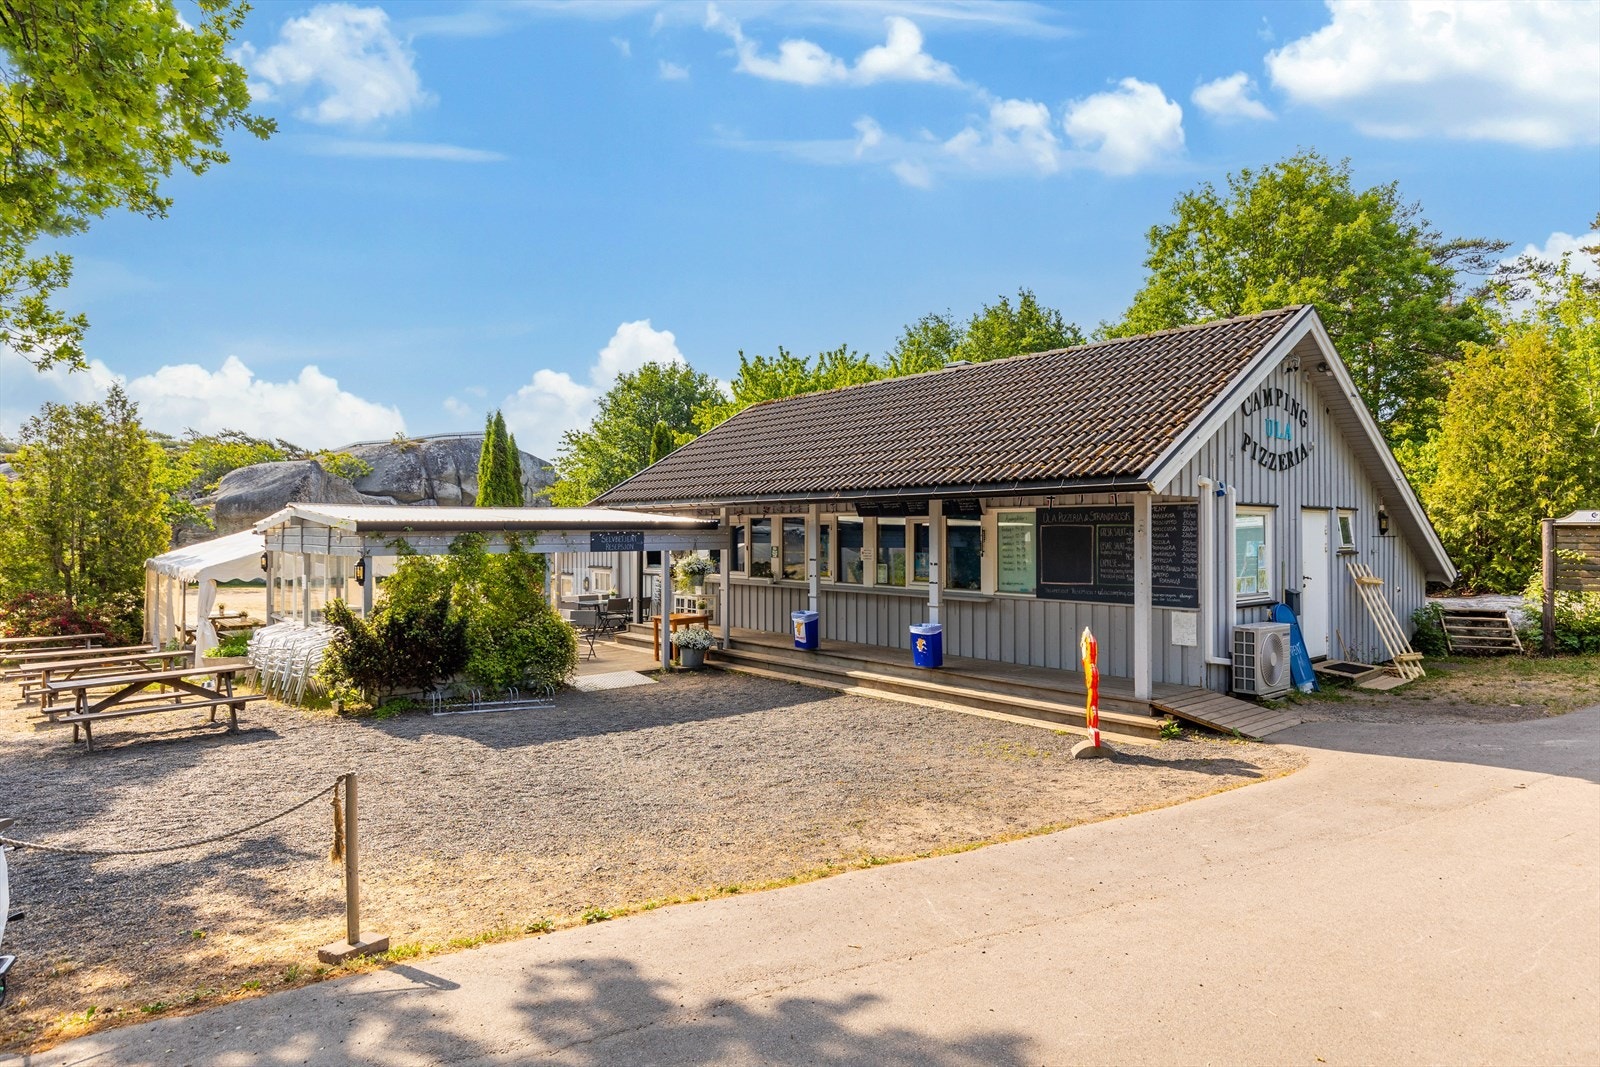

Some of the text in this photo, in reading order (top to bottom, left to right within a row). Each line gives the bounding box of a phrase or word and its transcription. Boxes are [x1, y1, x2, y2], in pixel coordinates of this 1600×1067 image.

[1241, 387, 1308, 427] CAMPING
[1265, 418, 1292, 440] ULA
[1241, 432, 1308, 471] PIZZERIA
